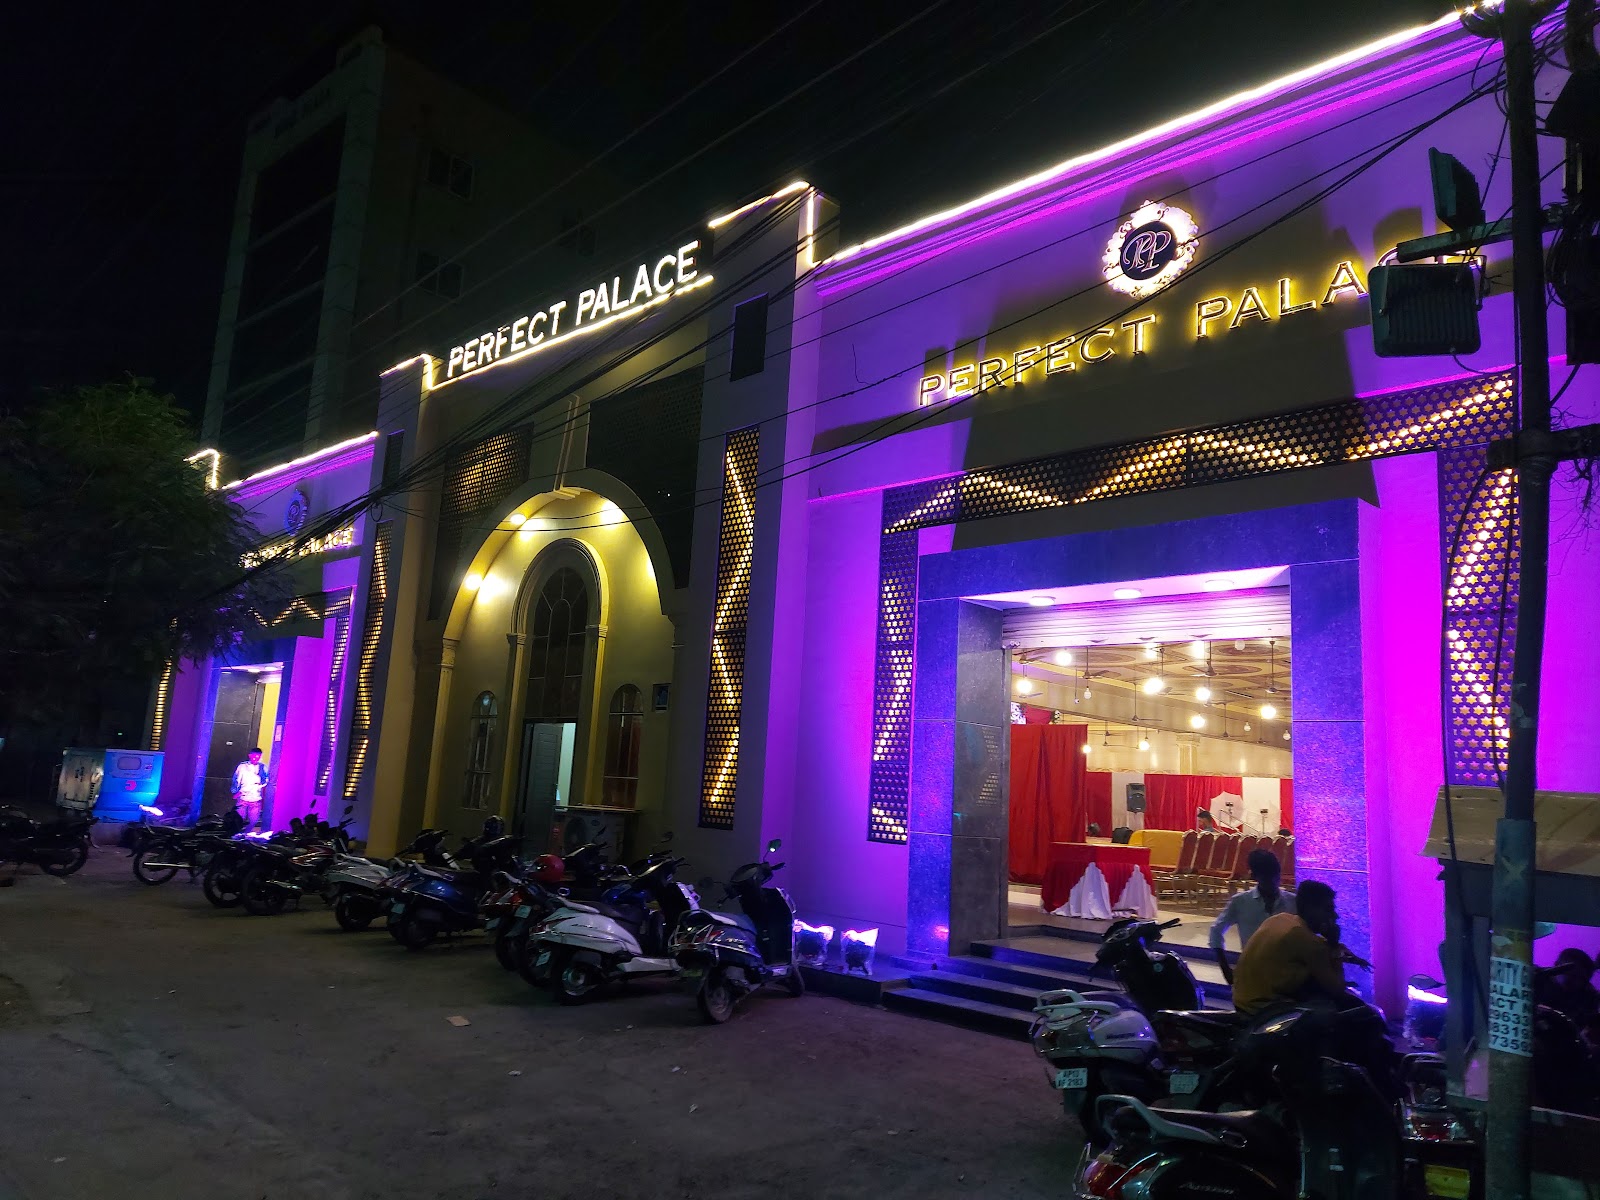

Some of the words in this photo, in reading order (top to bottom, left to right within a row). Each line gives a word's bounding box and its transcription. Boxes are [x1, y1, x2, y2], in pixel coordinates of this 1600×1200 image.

[446, 299, 567, 379] PERFECT
[574, 239, 700, 327] PALACE
[918, 313, 1156, 408] PERFECT
[1194, 247, 1482, 339] PALA
